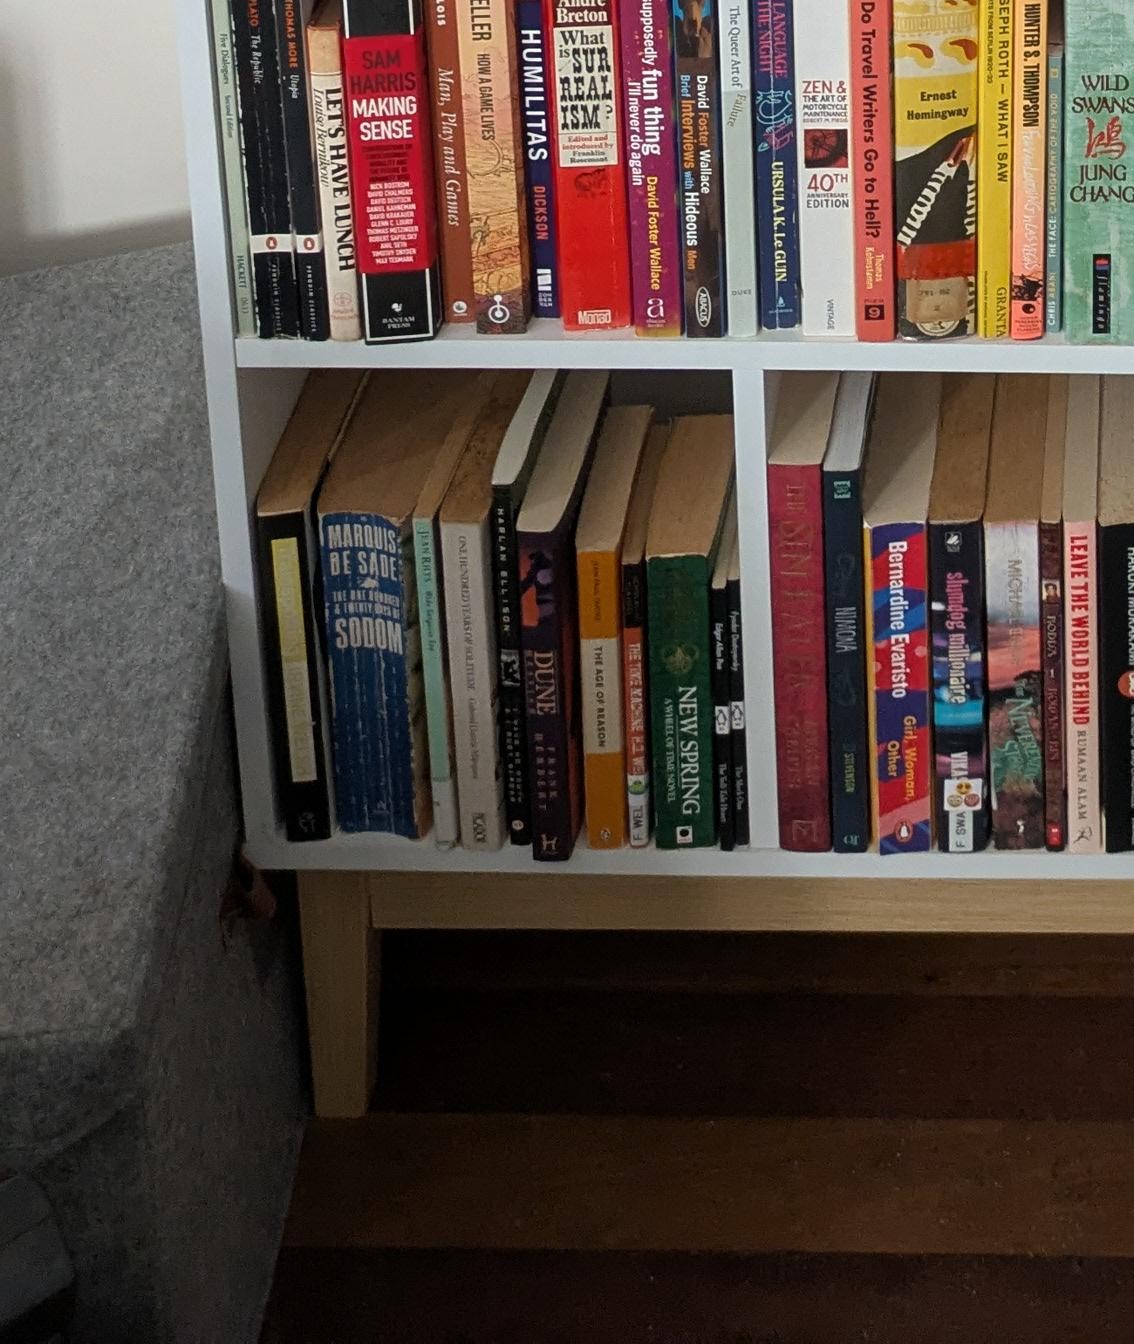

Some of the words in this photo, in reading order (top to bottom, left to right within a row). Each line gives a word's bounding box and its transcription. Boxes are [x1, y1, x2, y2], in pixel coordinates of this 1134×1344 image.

[556, 8, 608, 24] Breton
[861, 28, 877, 79] Travel
[352, 96, 416, 117] MAKING
[520, 29, 548, 161] HUMILITAS
[906, 107, 969, 121] Hemingway
[359, 120, 413, 141] SENSE
[888, 541, 907, 629] Bernardine
[336, 620, 403, 653] SODOM
[891, 633, 909, 698] Evaristo
[678, 686, 696, 735] NEW
[681, 740, 699, 816] SPRING
